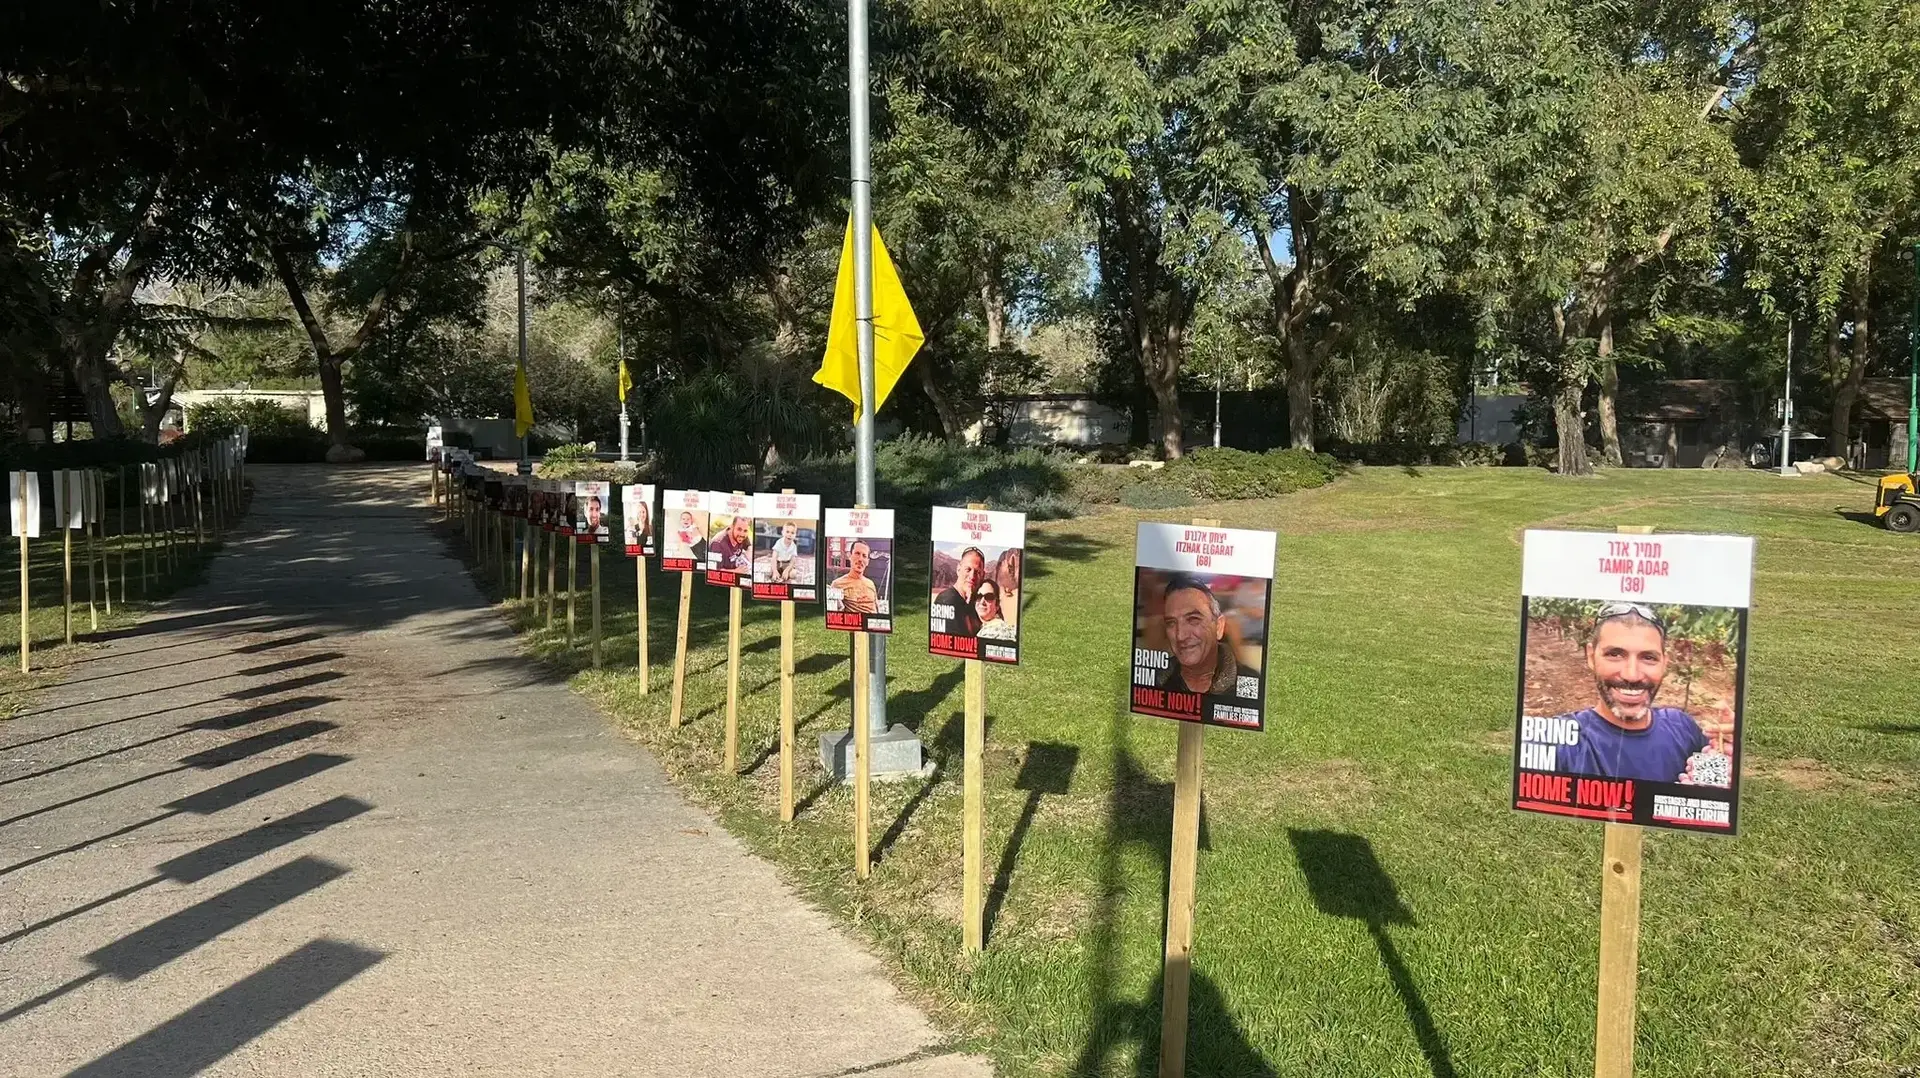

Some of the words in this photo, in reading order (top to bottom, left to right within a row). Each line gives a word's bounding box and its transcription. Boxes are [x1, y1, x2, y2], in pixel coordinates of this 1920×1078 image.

[1209, 532, 1227, 543] יצחק
[1176, 541, 1200, 553] ITZHAK
[1202, 544, 1234, 556] ELGARAT
[1608, 540, 1630, 557] אדר
[1633, 542, 1661, 558] תמיר
[1196, 555, 1211, 567] (68)
[1599, 558, 1633, 574] TAMIR
[1637, 560, 1669, 576] ADAR
[1620, 576, 1644, 594] (38)
[931, 603, 955, 619] BRING
[931, 618, 946, 633] HIM
[931, 633, 952, 649] HOME
[954, 636, 977, 653] NOW!
[1135, 648, 1169, 669] BRING
[1134, 667, 1155, 686] HIM
[1133, 687, 1164, 708] HOME
[1168, 692, 1201, 714] NOW!
[1521, 716, 1579, 746] BRING
[1520, 743, 1557, 771] HIM
[1519, 772, 1571, 802] HOME
[1577, 778, 1634, 811] NOW!
[1653, 804, 1694, 819] FAMILIES
[1696, 808, 1730, 824] FORUM
